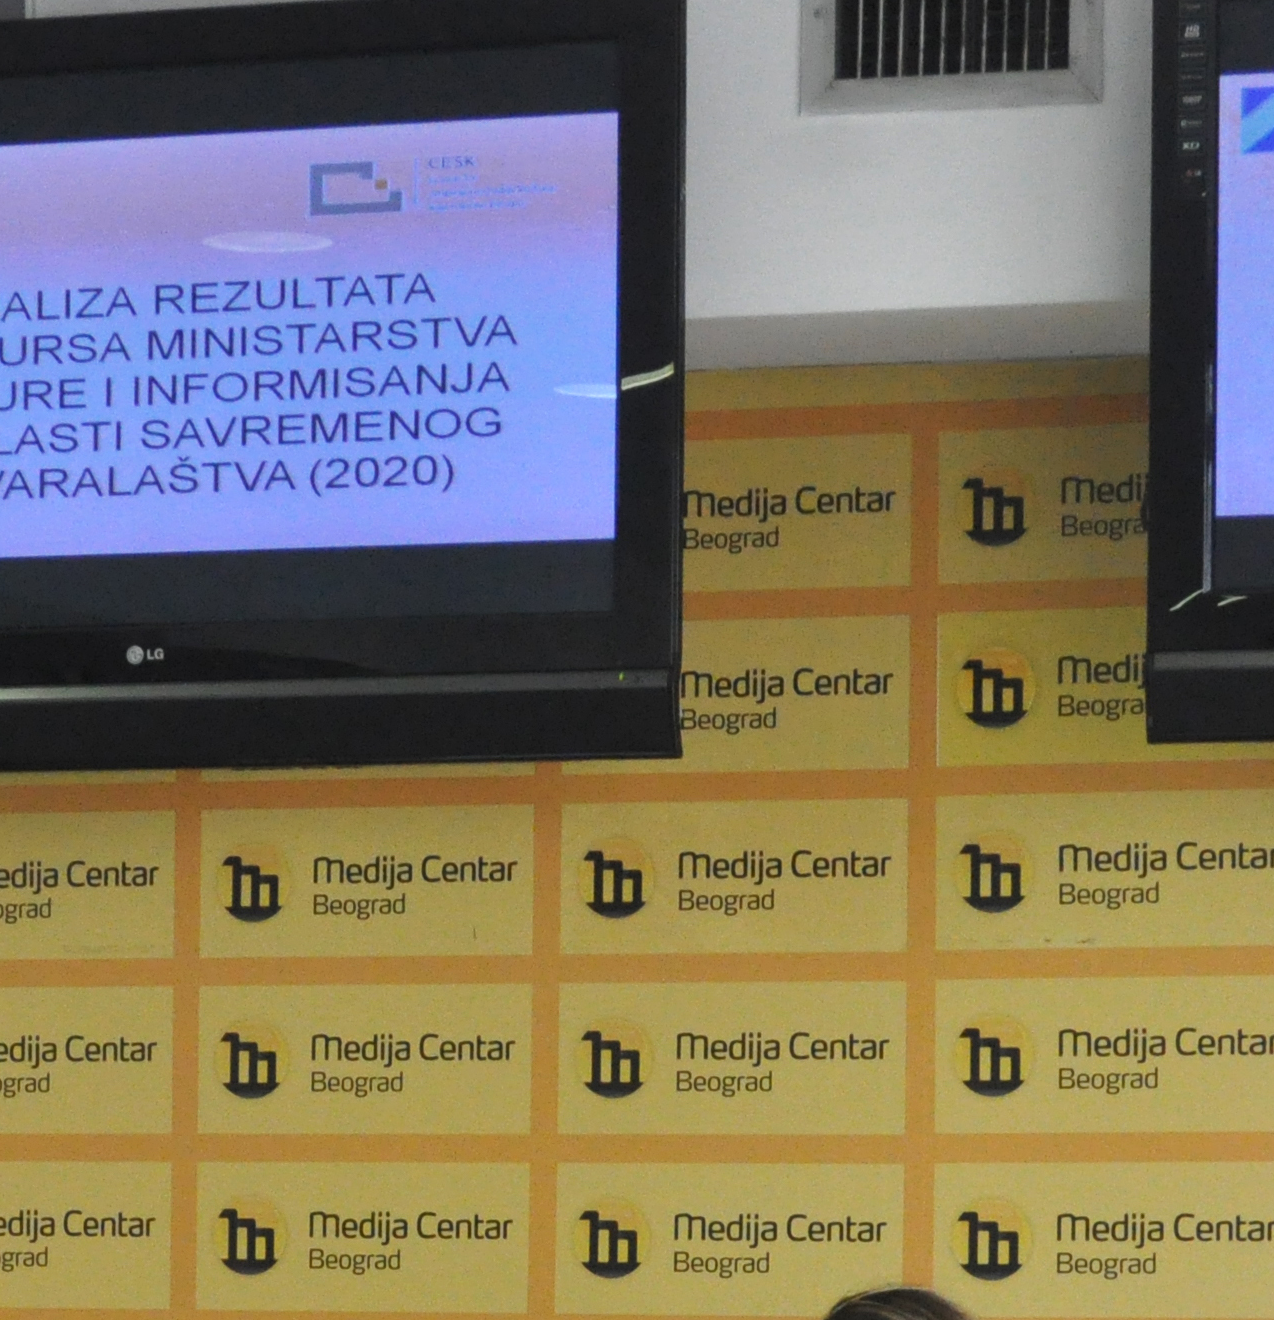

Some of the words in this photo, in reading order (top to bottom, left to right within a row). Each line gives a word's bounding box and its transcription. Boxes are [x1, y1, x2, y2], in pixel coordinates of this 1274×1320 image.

[154, 273, 436, 315] REZULTATA
[147, 315, 517, 361] MINISTARSTVA
[133, 361, 510, 406] INFORMISANJA
[141, 406, 502, 450] SAVREMENOG
[309, 454, 455, 497] (2020)
[146, 647, 165, 660] LG
[680, 669, 785, 705] Medija
[792, 667, 894, 697] Centar
[680, 706, 778, 735] Beograd
[66, 860, 159, 888] Centar
[677, 850, 783, 886] Medija
[790, 849, 892, 879] Centar
[1058, 842, 1168, 879] Medija
[678, 889, 775, 916] Beograd
[1058, 882, 1160, 910] Beograd
[310, 1033, 412, 1069] Medija
[418, 1032, 516, 1062] Centar
[1057, 1027, 1167, 1065] Medija
[310, 1071, 404, 1098] Beograd
[1058, 1067, 1159, 1095] Beograd
[62, 1209, 156, 1238] Centar
[673, 1212, 779, 1253] Medija
[785, 1213, 887, 1243] Centar
[673, 1250, 770, 1279] Beograd
